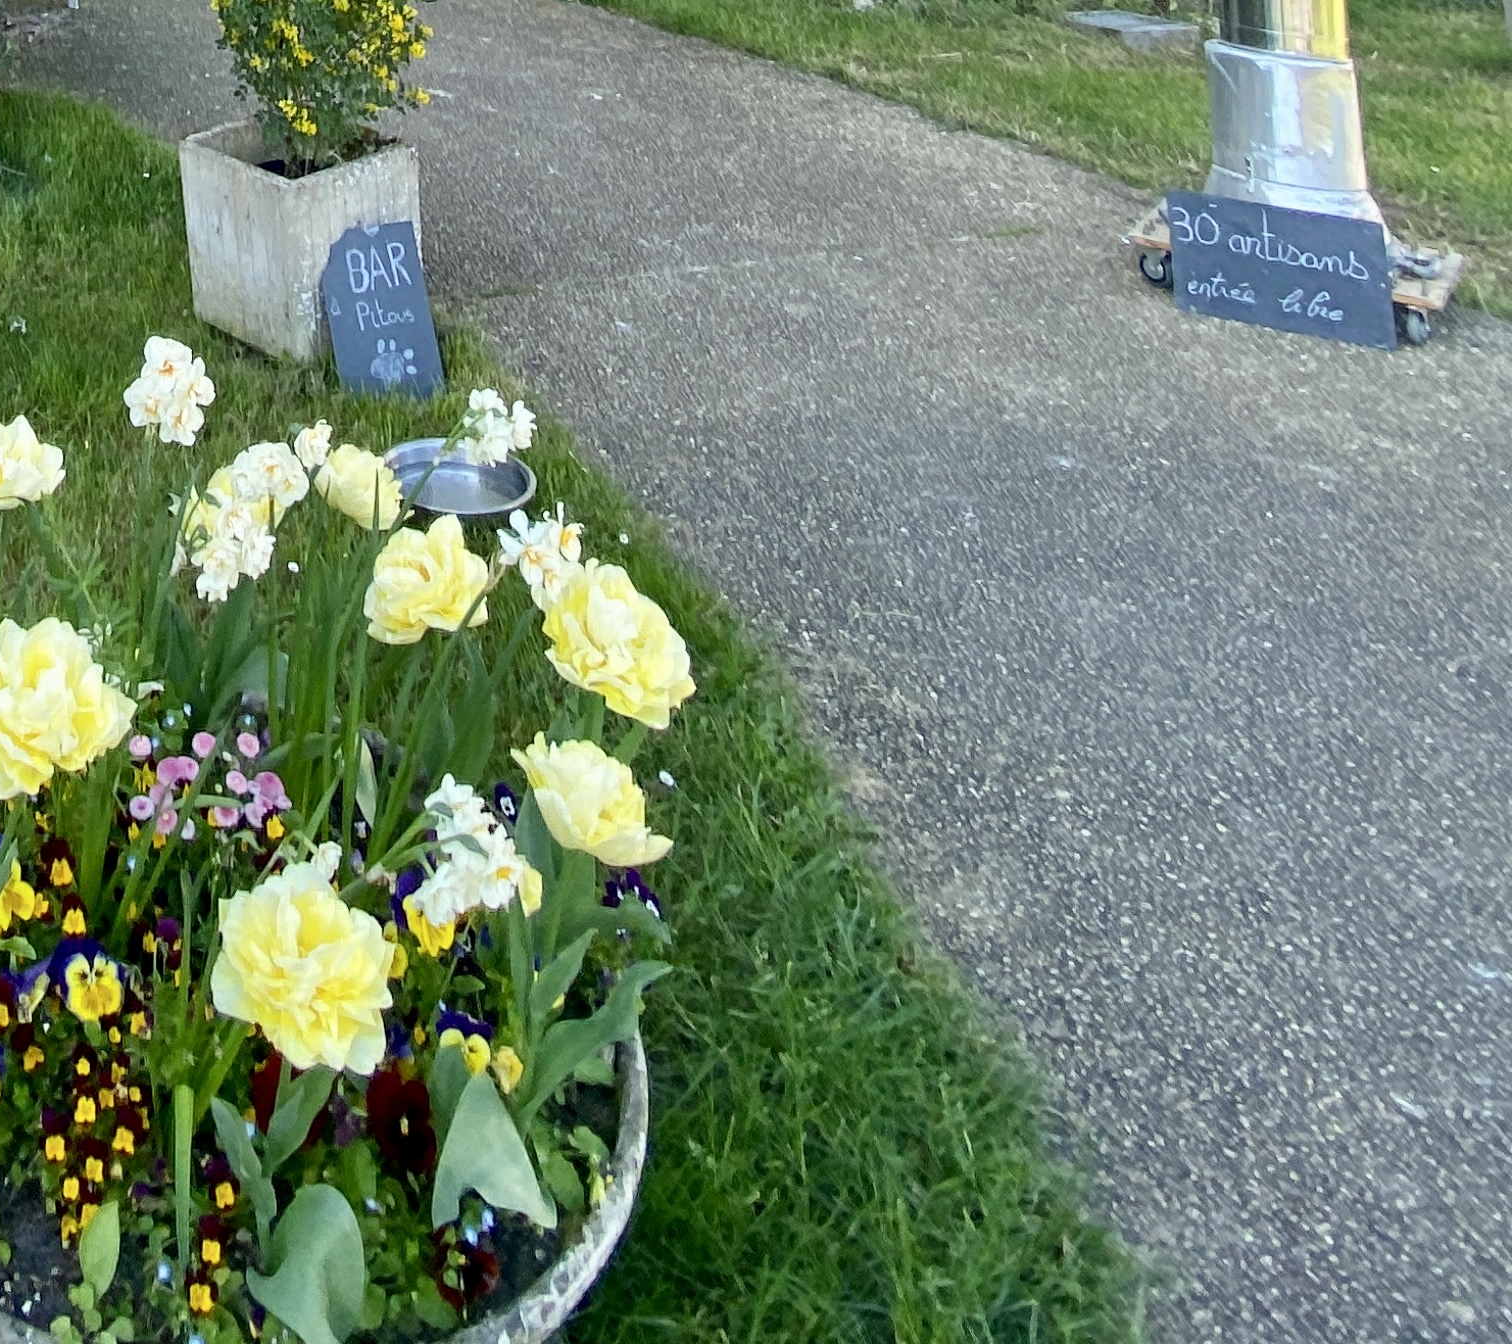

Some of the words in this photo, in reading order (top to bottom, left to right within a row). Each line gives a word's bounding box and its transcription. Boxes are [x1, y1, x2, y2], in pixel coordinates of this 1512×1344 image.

[345, 242, 412, 294] BAR
[1171, 206, 1220, 245] 30
[1228, 209, 1369, 280] artisans
[355, 299, 415, 332] Pitous
[1188, 270, 1256, 304] entrée
[1278, 289, 1344, 321] libre
